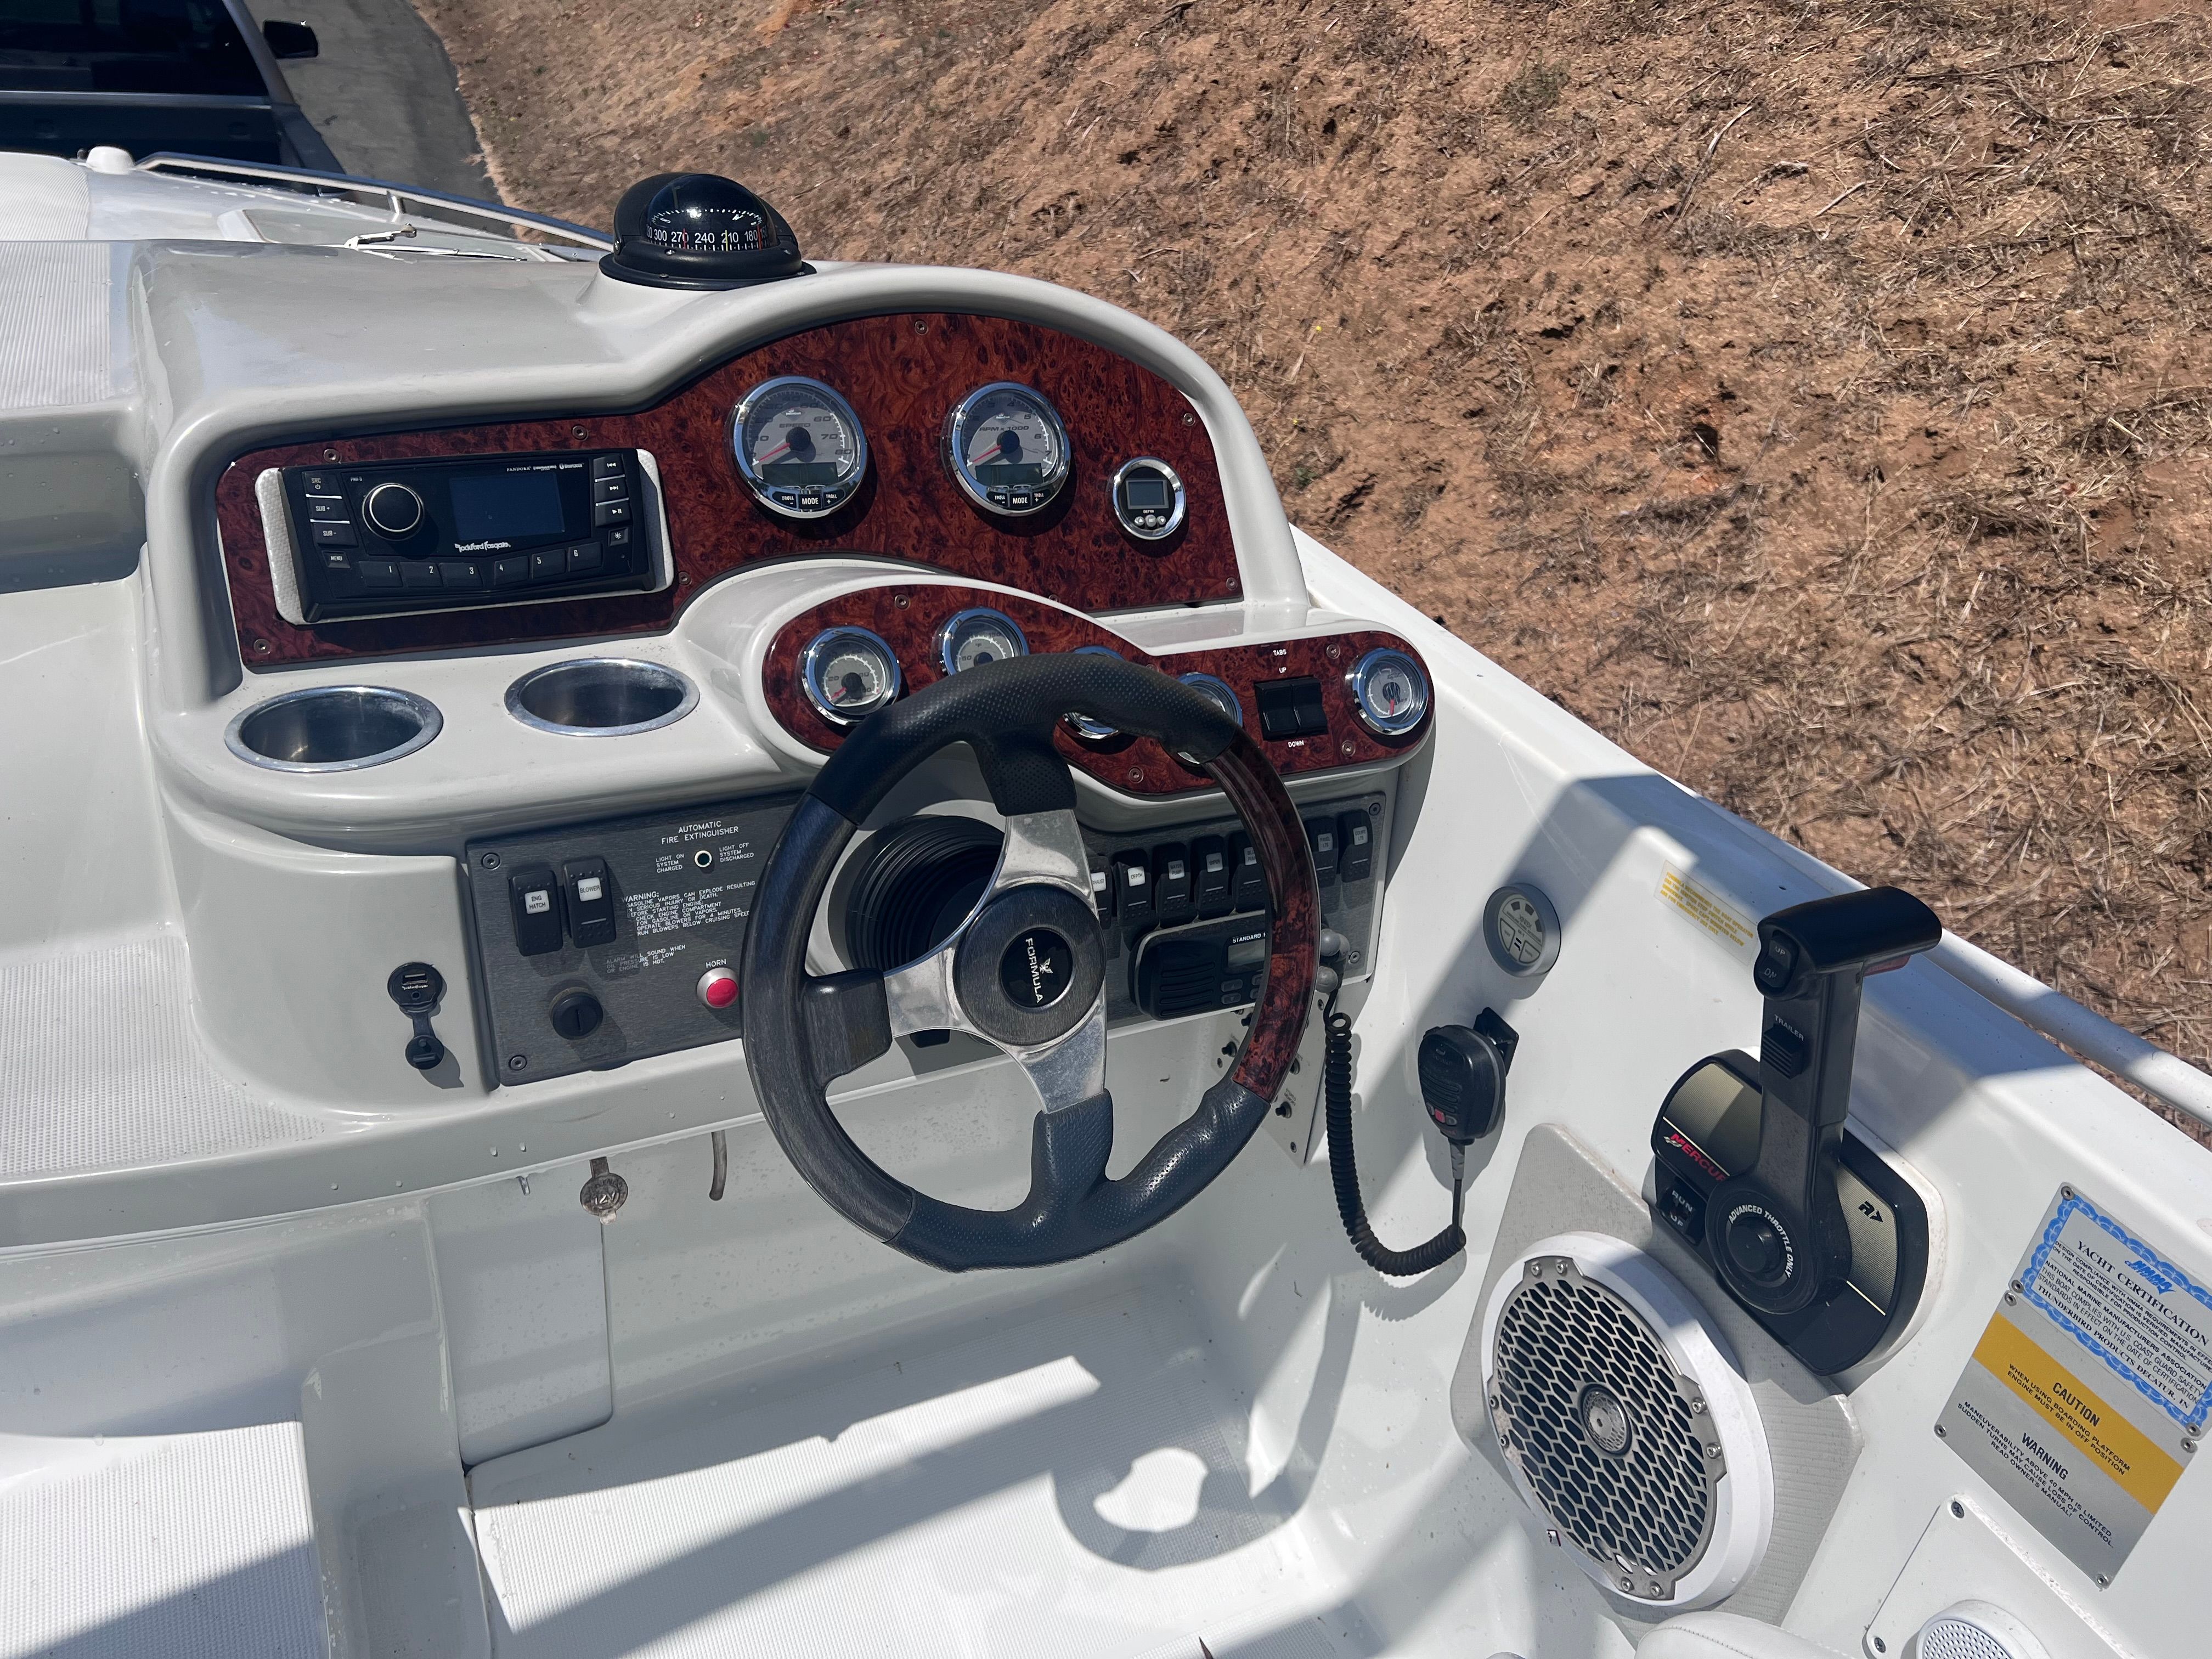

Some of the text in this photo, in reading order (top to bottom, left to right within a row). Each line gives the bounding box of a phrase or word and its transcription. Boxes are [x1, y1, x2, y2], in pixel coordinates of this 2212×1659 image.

[654, 229, 758, 244] 300 270 240 210 180
[454, 541, 511, 553] Rockford Fosgate
[662, 826, 739, 844] FIRE EXTINGUISHER
[678, 821, 721, 833] AUTOMATIC
[657, 865, 683, 873] CHARGED
[720, 853, 754, 862] DISCHARGED
[579, 885, 600, 894] BLOWER
[621, 891, 659, 902] WARNING:
[627, 899, 654, 908] GASOLINE
[658, 894, 680, 902] VAPORS
[698, 887, 723, 895] EXPLODE
[727, 881, 755, 890] RESULTING
[636, 902, 661, 911] SERIOUS
[652, 905, 679, 913] STARTING
[652, 915, 679, 923] GASOLINE
[695, 907, 718, 916] VAPORS.
[658, 910, 678, 918] ENGINE
[682, 901, 721, 913] COMPARTMENT
[637, 922, 661, 931] OPERATE
[665, 917, 691, 926] BLOWERS
[718, 907, 742, 916] MINUTES.
[652, 924, 679, 933] BLOWERS
[705, 915, 730, 923] CRUISING
[1232, 933, 1261, 943] STANDARD
[606, 956, 625, 964] ALARM
[620, 957, 648, 966] PRESSURE
[1775, 946, 1786, 955] UP
[706, 959, 727, 969] HORN
[1025, 938, 1043, 1003] FORMULA
[1774, 1014, 1804, 1041] TRAILER
[1670, 1132, 1726, 1181] MERCUR
[1672, 1190, 1693, 1212] RUN
[1858, 1200, 1875, 1216] R
[1729, 1204, 1794, 1278] ADVANCED THROTTLE ONLY
[2055, 1241, 2075, 1259] DESIGN
[2075, 1257, 2111, 1285] COMPLIANCE
[2111, 1284, 2126, 1297] WITH
[2126, 1296, 2143, 1312] NMMA
[2145, 1310, 2188, 1346] REQUIREMENTS
[2061, 1253, 2136, 1312] THE DATE CERTIFICATION
[2078, 1240, 2115, 1273] YACHT
[2117, 1272, 2210, 1346] CERTIFICATION
[2045, 1260, 2207, 1390] NATIONAL MARINE MANUFACTURERS ASSOCIATION
[2073, 1268, 2113, 1300] RESPONSIBLE
[2111, 1298, 2122, 1310] FOR
[2123, 1308, 2159, 1338] PRODUCTION
[2160, 1337, 2186, 1361] CONTROL
[2038, 1273, 2199, 1404] STANDARDS IN EFFECT ON THE DATE OF CERTIFICATION
[2042, 1267, 2204, 1397] THIS BOAT COMPLIES WITH COAST GUARD SAFETY
[2038, 1284, 2191, 1409] THUNDERBIRD PRODUCTS DECATUR, IN
[2052, 1382, 2101, 1427] CAUTION
[2007, 1370, 2125, 1475] ENGINE MUST BE IN OFF POSITION
[2009, 1363, 2131, 1471] WHEN USING BOARDING PLATFORM
[2021, 1432, 2069, 1480] WARNING
[1957, 1403, 2113, 1548] SUDDEN TURNS MAY CAUSE LOSS OF CONTROL.
[1964, 1401, 2112, 1537] MANEUVERABILITY ABOVE 40 MPH IS LIMITED
[1991, 1440, 2073, 1518] READ OWNER'S MANUAL!
